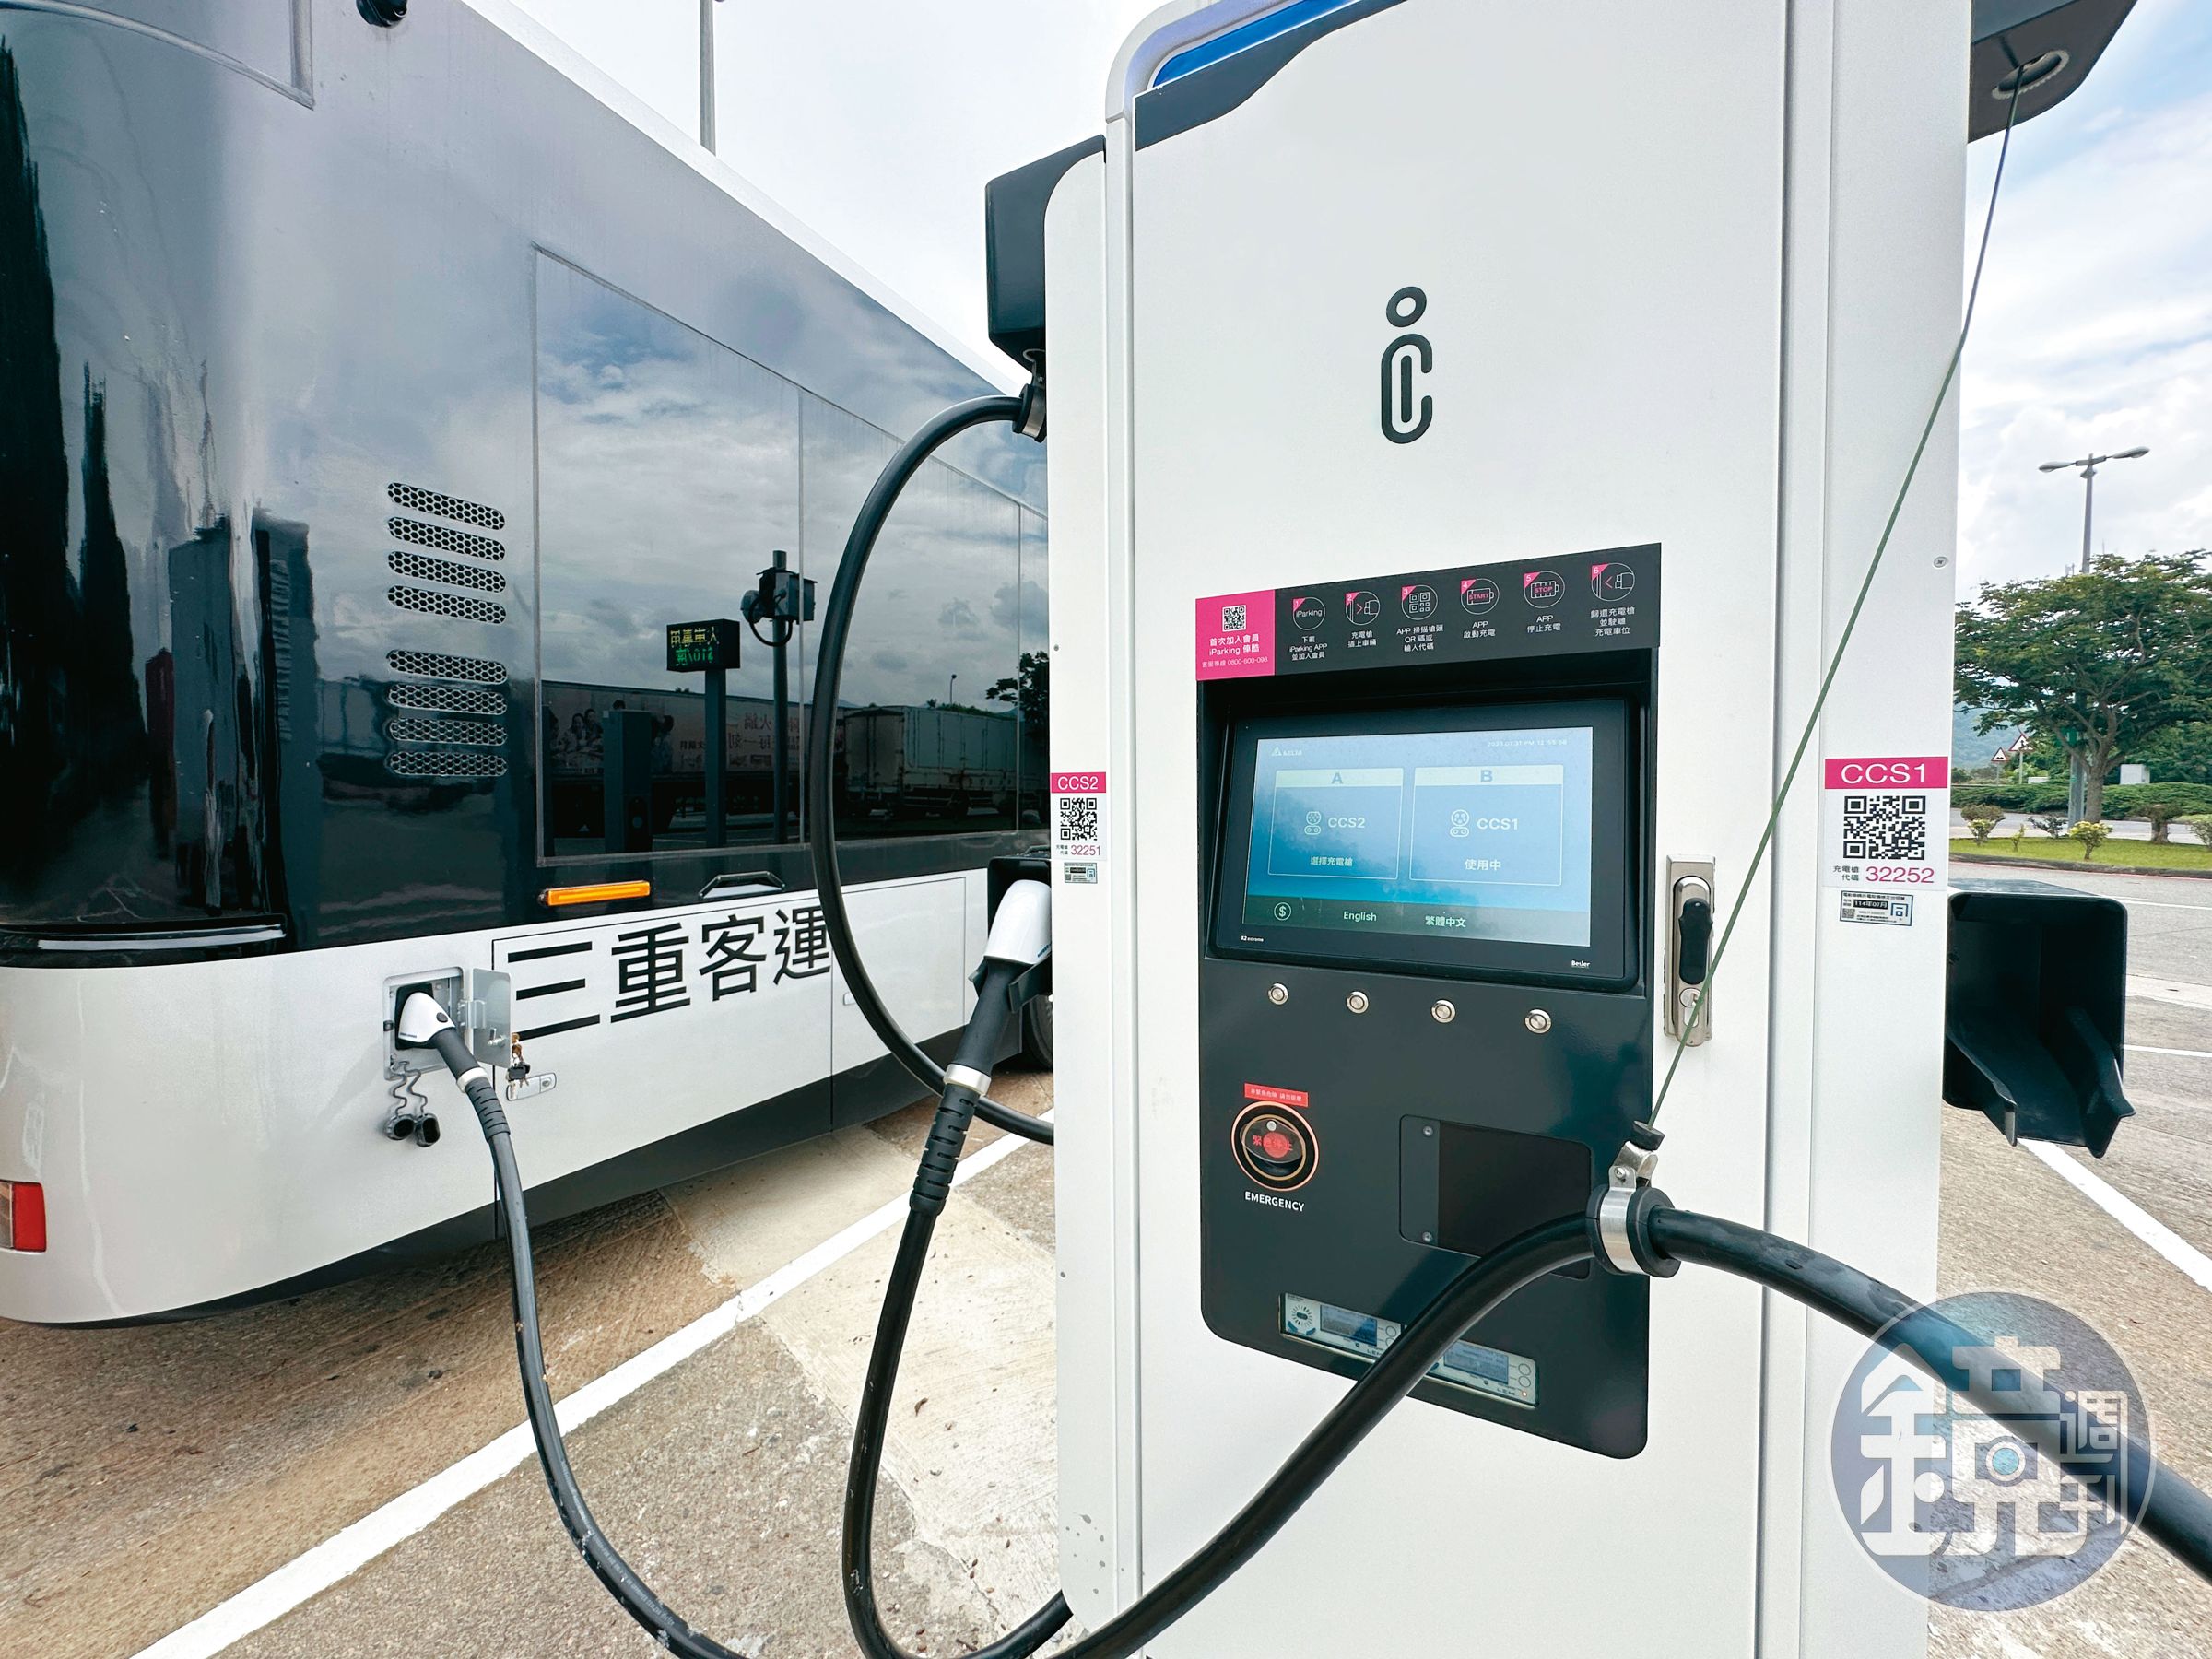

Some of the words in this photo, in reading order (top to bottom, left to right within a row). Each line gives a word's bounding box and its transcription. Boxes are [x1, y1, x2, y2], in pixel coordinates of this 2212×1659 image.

[1472, 620, 1488, 629] APP
[1536, 615, 1554, 623] APP
[1396, 627, 1411, 635] APP
[1527, 622, 1561, 633] 停止充電
[1595, 627, 1630, 637] 充電車位
[1209, 633, 1260, 646] 首次加入會員
[1209, 647, 1241, 656] iParking
[1313, 642, 1327, 651] APP
[1331, 771, 1344, 784] A
[1480, 770, 1493, 782] B
[1841, 763, 1925, 784] CCS1
[1057, 776, 1099, 790] CCS2
[1327, 817, 1366, 829] CCS2
[1477, 818, 1519, 830] CCS1
[1070, 845, 1100, 856] 32251
[1310, 856, 1353, 866] 選擇充電槍
[1465, 858, 1502, 871] 使用中
[1865, 866, 1935, 884] 32252
[1343, 911, 1377, 923] English
[1425, 915, 1466, 928] 繁體中文
[508, 905, 830, 1041] 三重客運
[1245, 1191, 1305, 1212] EMERGENCY
